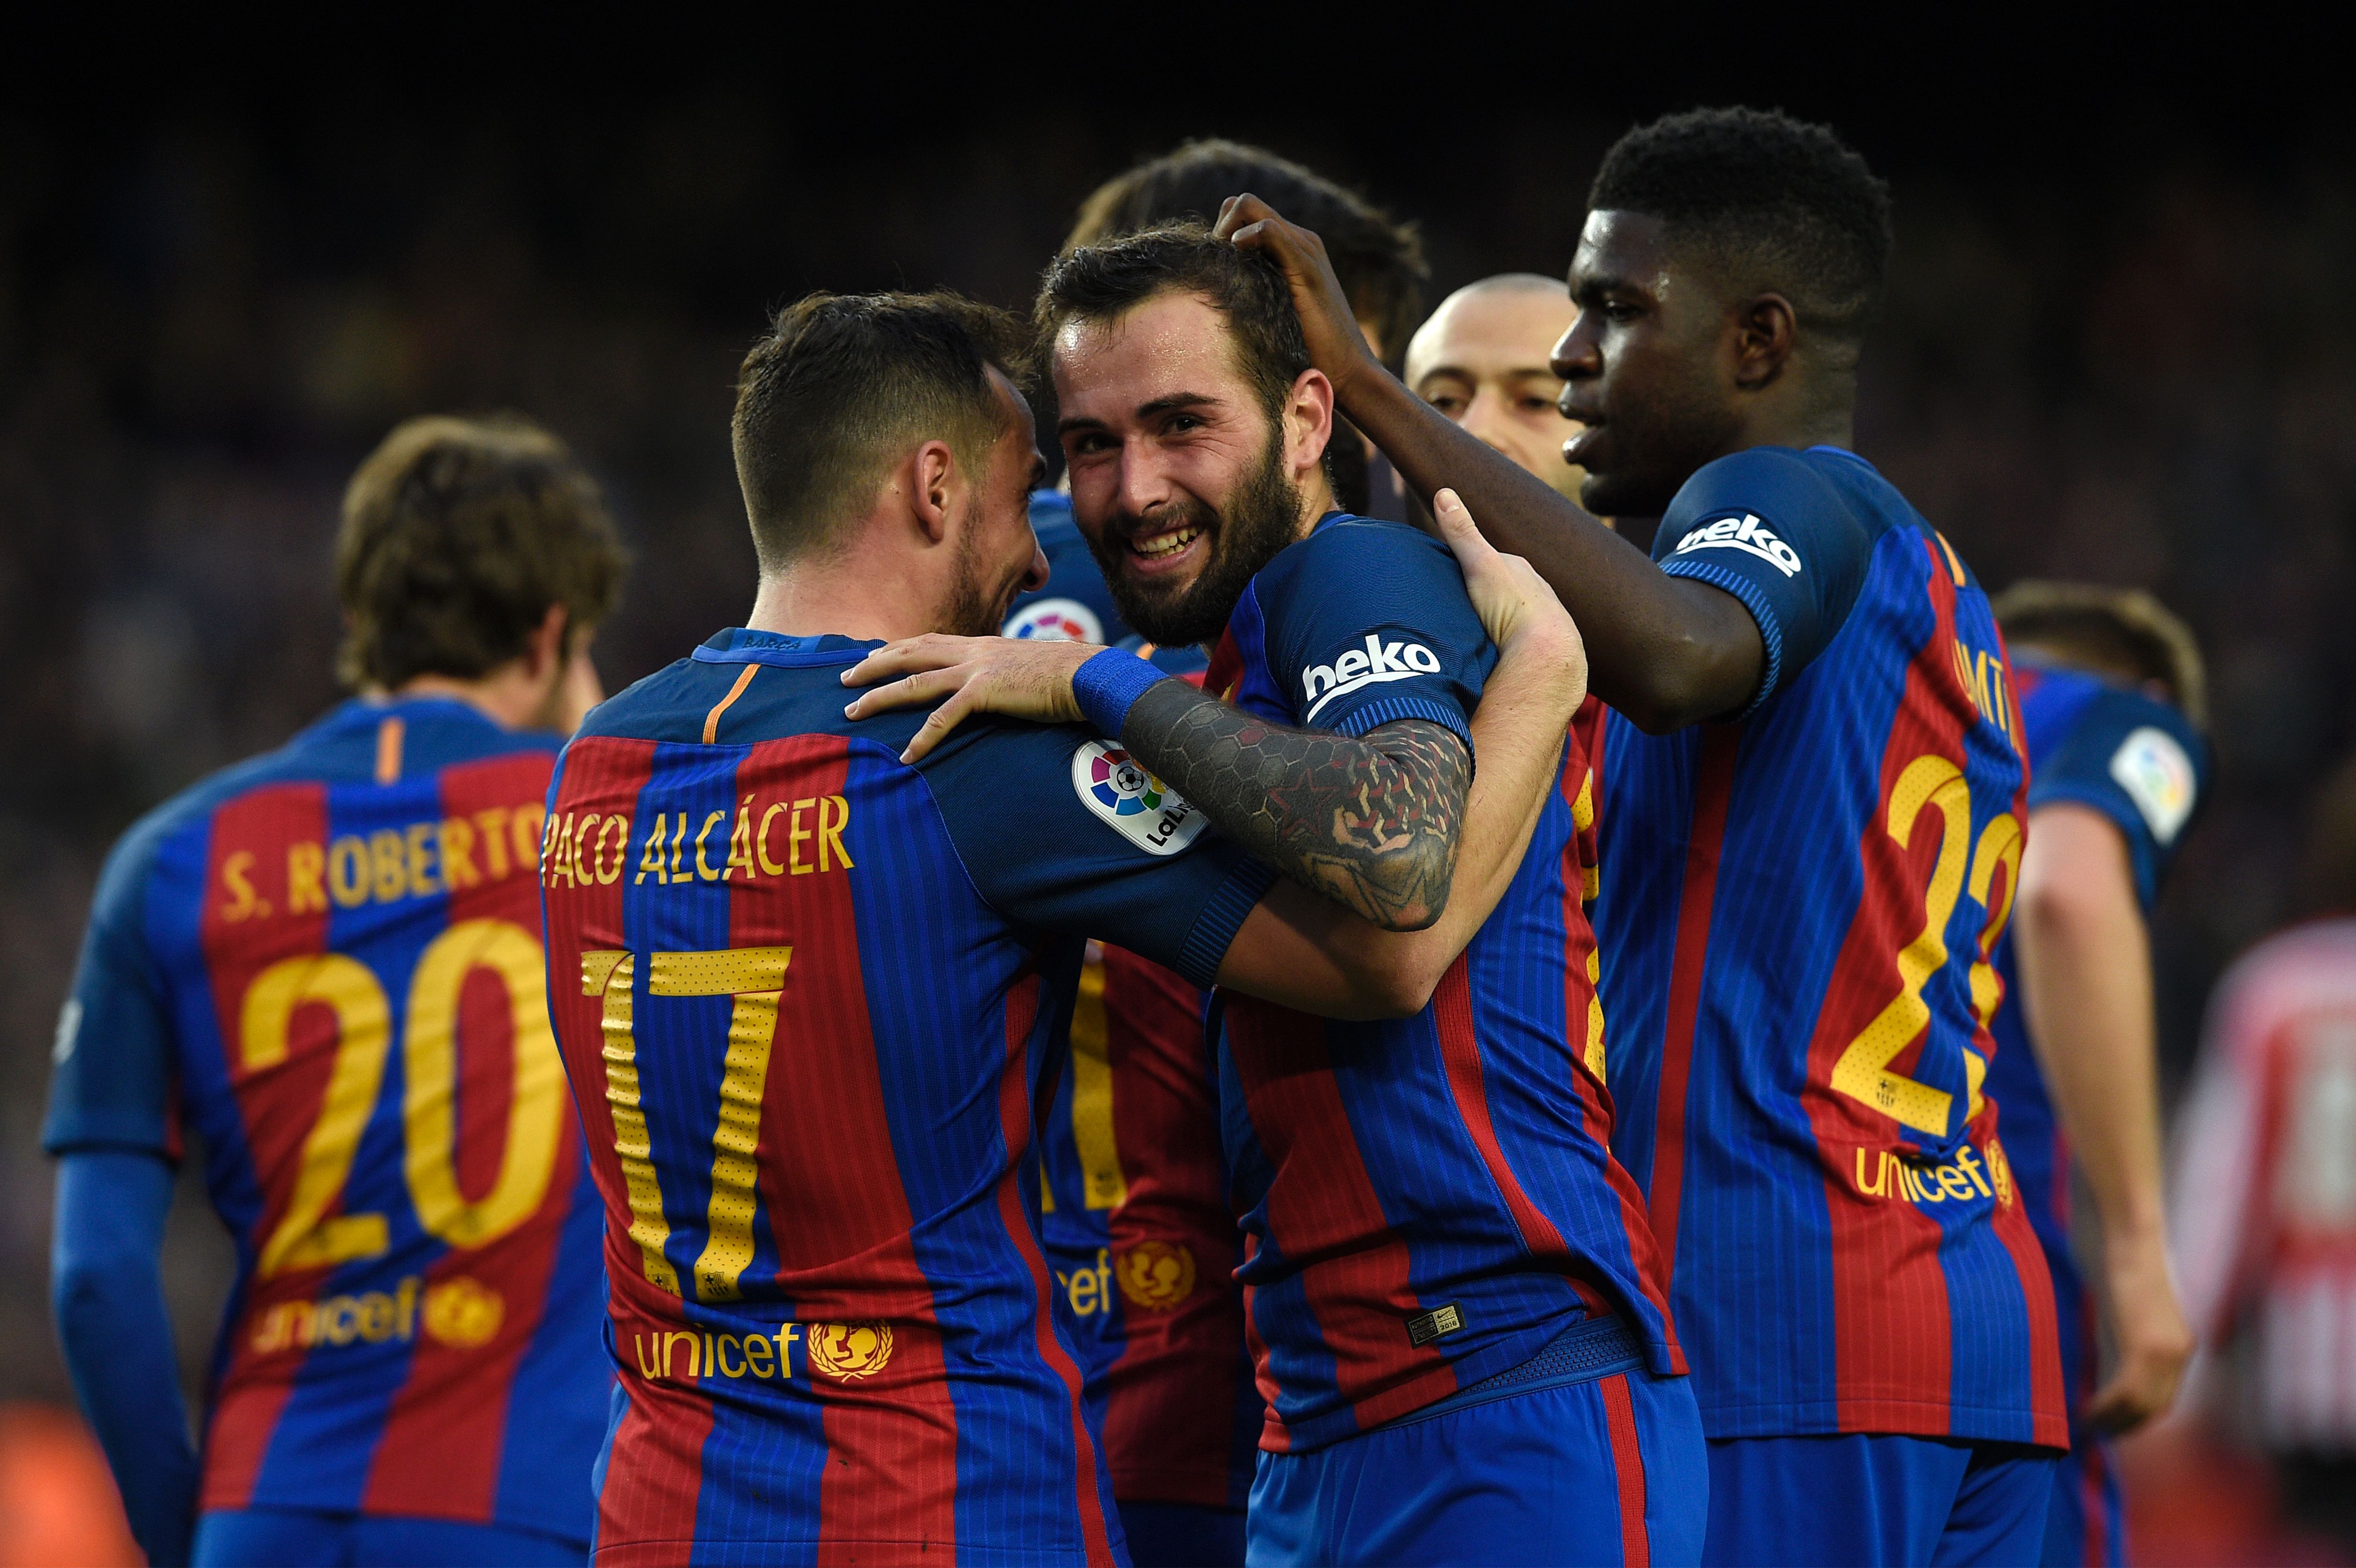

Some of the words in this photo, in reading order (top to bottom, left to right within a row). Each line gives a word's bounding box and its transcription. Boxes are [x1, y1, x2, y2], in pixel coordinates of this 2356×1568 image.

[1676, 513, 1802, 578] beko
[1302, 634, 1441, 724] beko
[221, 851, 273, 924] S.
[288, 802, 546, 913] ROBERTO
[540, 812, 629, 890] PACO
[633, 793, 855, 885] ALCÁCER
[240, 917, 568, 1280] 20
[580, 946, 794, 1303] 17
[1855, 1145, 1993, 1203] unicef
[634, 1322, 800, 1381] unicef
[1440, 1320, 1457, 1330] 2016
